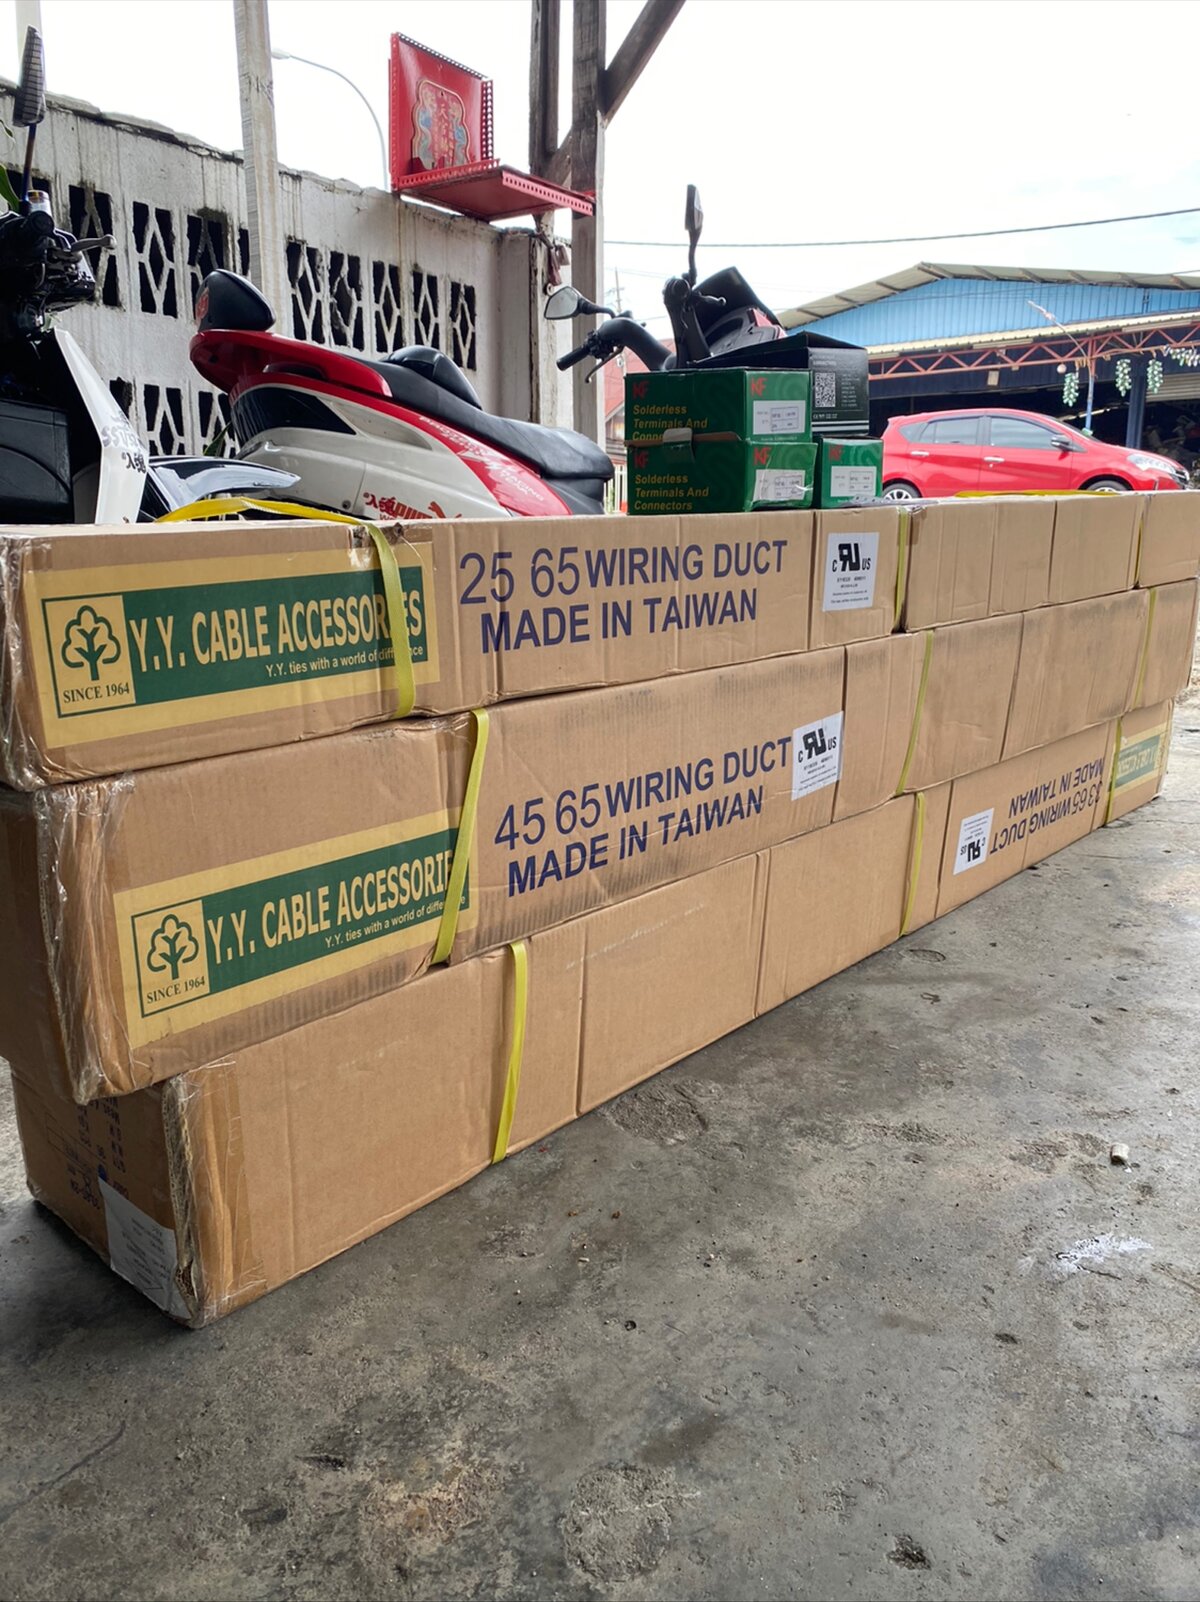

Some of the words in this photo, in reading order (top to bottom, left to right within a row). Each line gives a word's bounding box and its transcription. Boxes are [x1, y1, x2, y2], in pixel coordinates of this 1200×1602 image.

[633, 404, 687, 414] Solderless
[634, 418, 683, 428] Terminals
[686, 418, 708, 428] And
[635, 474, 688, 484] Solderless
[635, 488, 685, 498] Terminals
[686, 487, 709, 497] And
[634, 501, 693, 511] Connectors
[460, 551, 514, 605] 25
[531, 547, 580, 598] 65
[713, 540, 788, 578] DUCT
[481, 603, 590, 654] MADE
[601, 599, 632, 639] IN
[643, 588, 757, 633] TAIWAN
[129, 615, 186, 673] Y.Y.
[191, 605, 271, 665] CABLE
[265, 663, 287, 678] Y.Y.
[289, 661, 308, 674] ties
[309, 657, 330, 671] with
[332, 657, 339, 668] a
[340, 652, 366, 666] world
[368, 650, 378, 662] of
[63, 685, 103, 704] SINCE
[105, 682, 130, 697] 1964
[1059, 771, 1073, 794] IN
[1072, 757, 1105, 788] MADE
[494, 797, 546, 850] 45
[723, 736, 792, 784] DUCT
[1008, 779, 1057, 819] TAIWAN
[508, 832, 609, 898] MADE
[619, 820, 648, 860] IN
[657, 784, 763, 846] TAIWAN
[989, 818, 1027, 855] DUCT
[207, 909, 256, 965] Y.Y.
[261, 885, 331, 948] CABLE
[324, 933, 344, 949] Y.Y.
[345, 928, 363, 943] ties
[363, 920, 383, 936] with
[384, 920, 390, 930] a
[391, 908, 414, 927] world
[416, 904, 426, 919] of
[146, 982, 182, 1004] SINCE
[184, 975, 206, 992] 1964
